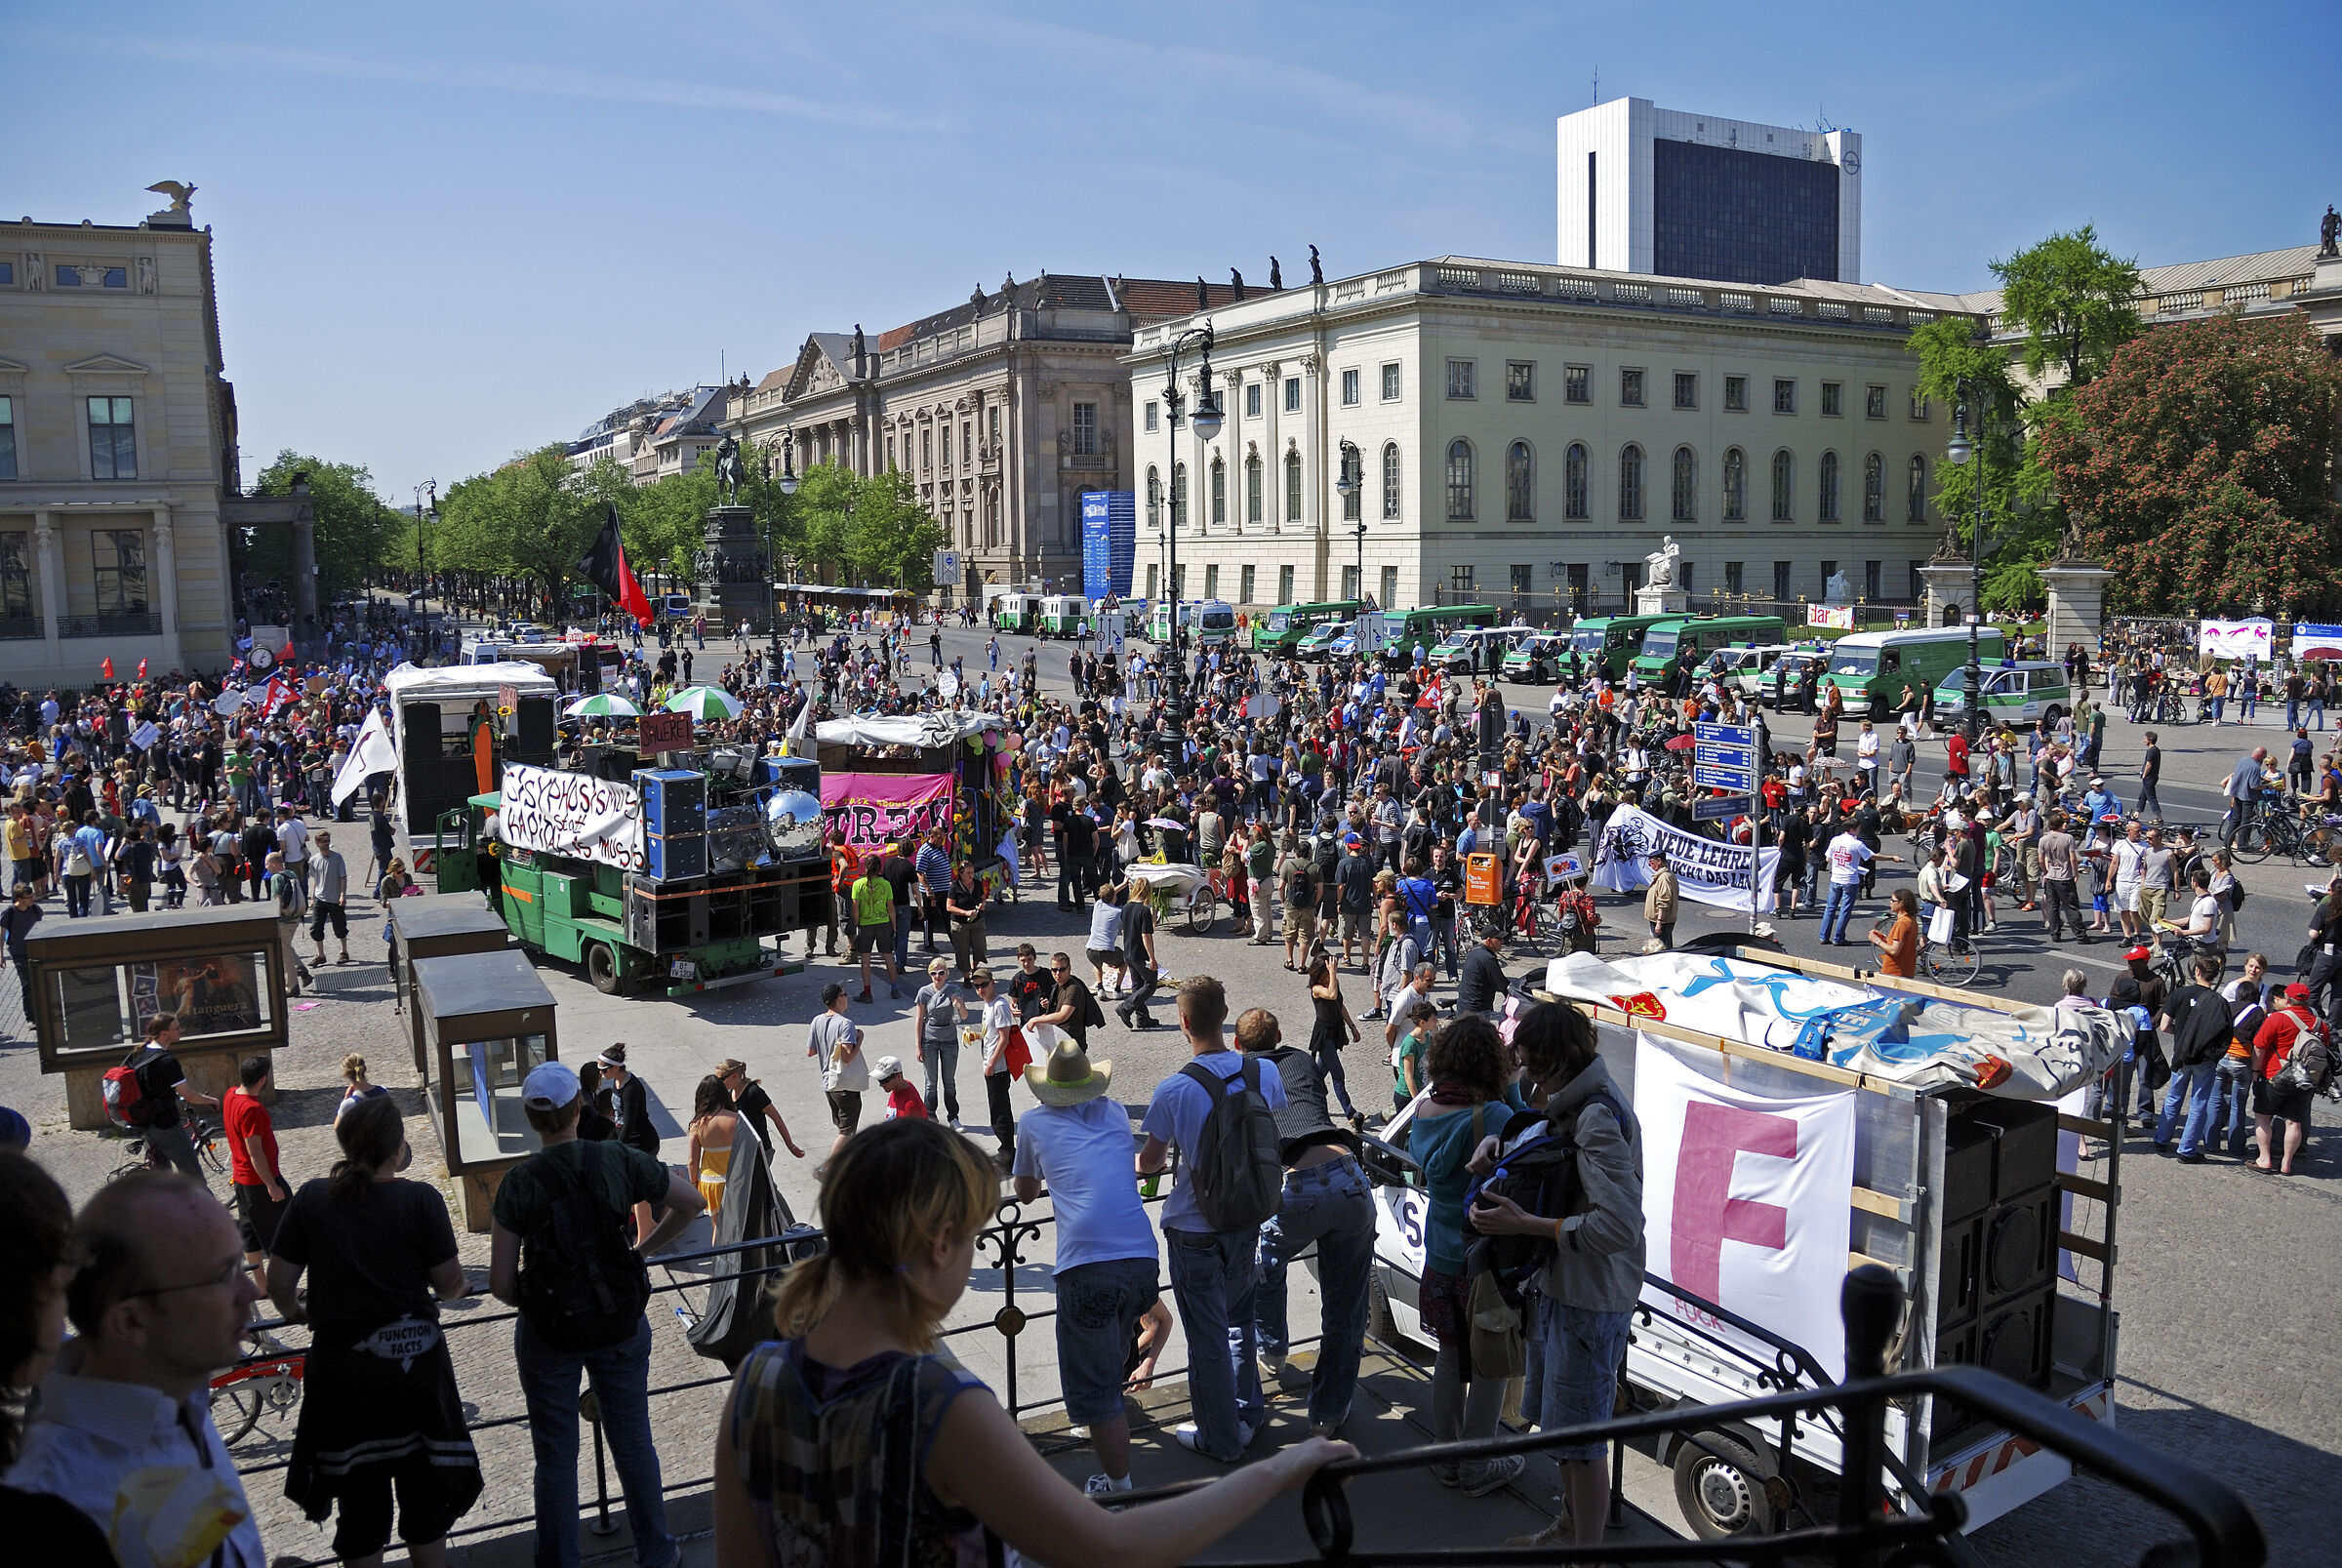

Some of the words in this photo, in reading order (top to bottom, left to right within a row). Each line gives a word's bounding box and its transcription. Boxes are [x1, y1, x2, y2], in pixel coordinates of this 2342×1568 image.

[1651, 829, 1698, 861] NEUE
[1699, 842, 1761, 870] LEHRE
[1706, 869, 1729, 885] DAS
[192, 1001, 248, 1016] tanguera
[1671, 1100, 1798, 1307] F
[1674, 1297, 1726, 1333] FUCK
[378, 1324, 431, 1343] FUNCTION
[391, 1340, 424, 1355] FACTS
